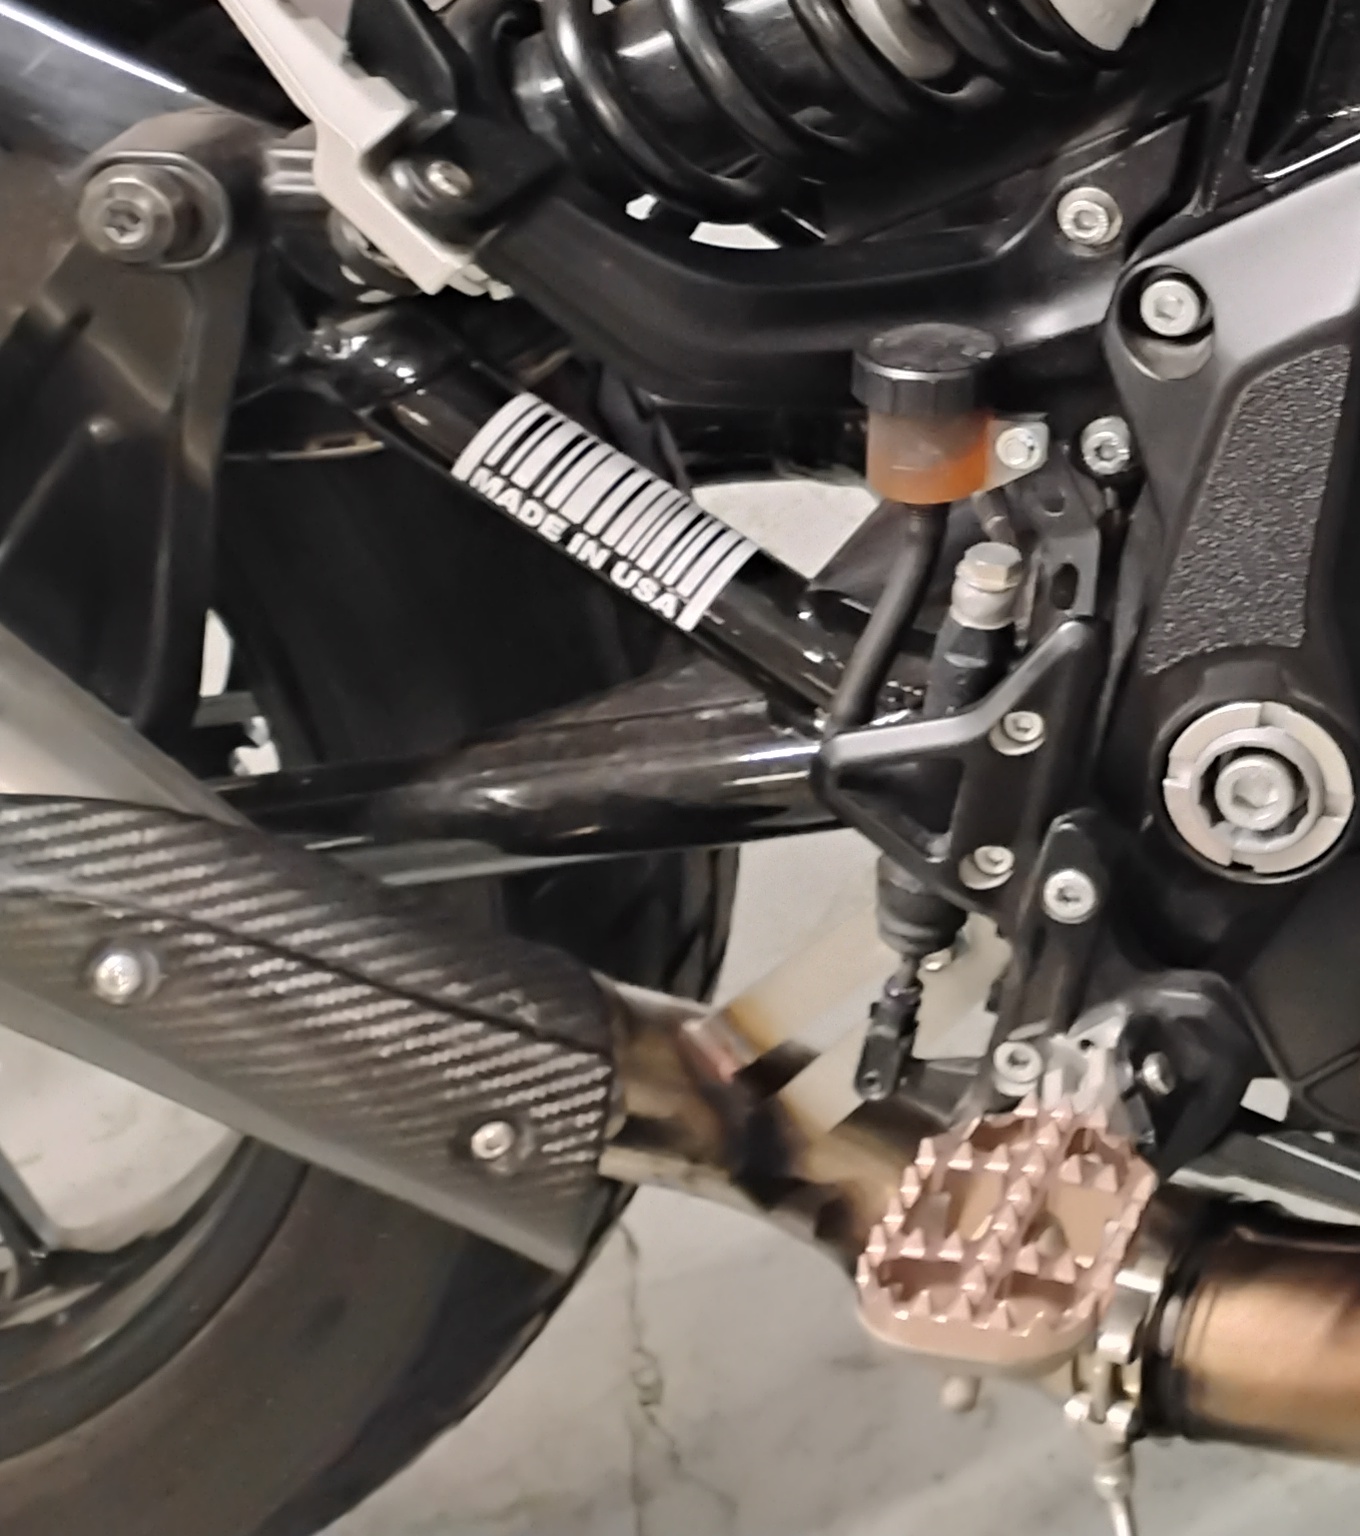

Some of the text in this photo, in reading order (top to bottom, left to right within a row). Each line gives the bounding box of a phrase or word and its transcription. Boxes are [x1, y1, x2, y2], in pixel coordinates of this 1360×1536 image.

[471, 467, 682, 620] MADE IN USA
